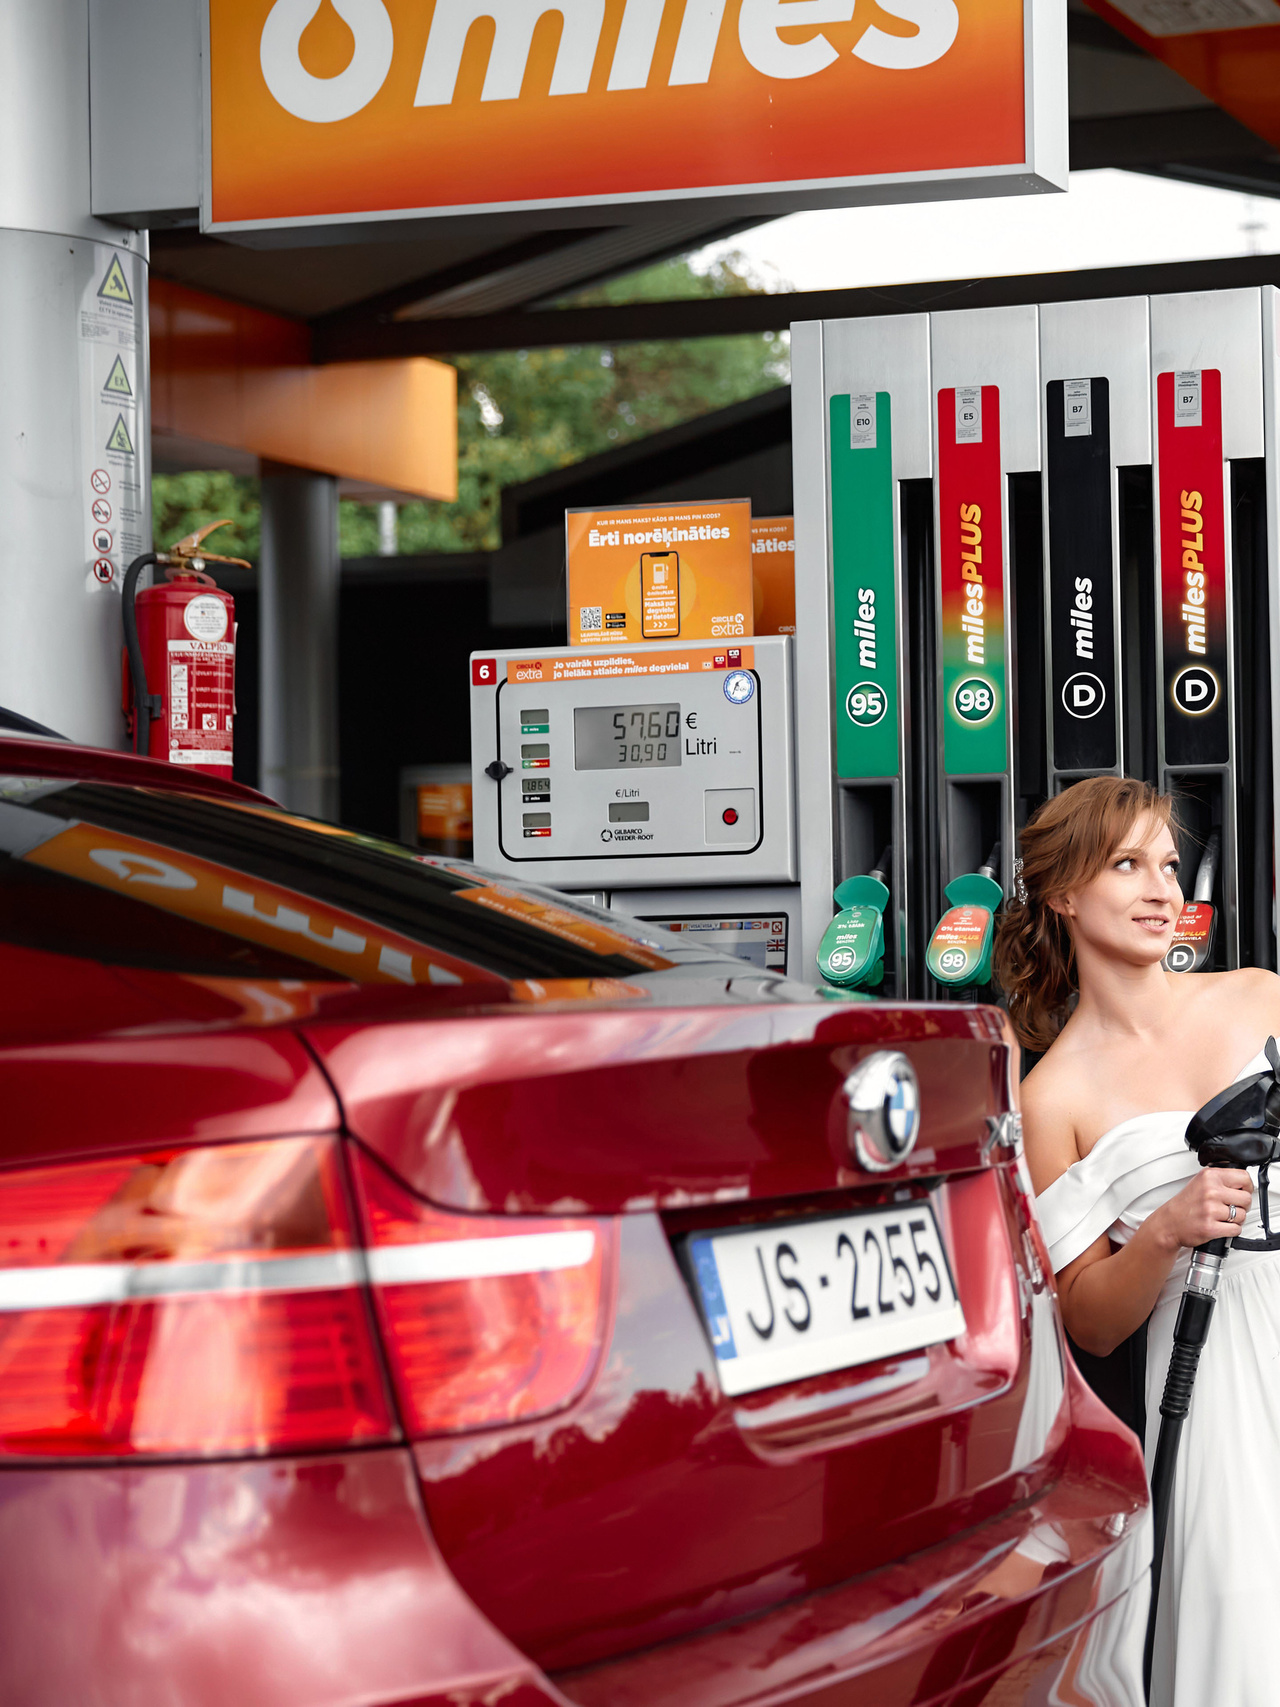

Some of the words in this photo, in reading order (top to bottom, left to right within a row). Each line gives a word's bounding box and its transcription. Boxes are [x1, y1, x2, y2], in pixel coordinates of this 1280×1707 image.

[412, 0, 960, 108] miles
[114, 376, 125, 387] EX
[1183, 396, 1193, 404] B7
[963, 412, 974, 420] E5
[1072, 405, 1083, 413] B7
[856, 418, 870, 426] E10
[652, 515, 667, 523] KĀDS
[588, 529, 620, 547] Ērti
[623, 525, 730, 548] norēķināties
[1070, 577, 1094, 659] miles
[712, 623, 744, 636] extra
[853, 588, 876, 669] miles
[190, 642, 228, 652] VALPRO
[553, 660, 565, 670] Jo
[568, 658, 592, 668] vairāk
[594, 656, 635, 668] uzpildies,
[479, 665, 490, 679] 6
[516, 670, 543, 681] extra
[553, 670, 562, 680] jo
[564, 666, 591, 677] lielāka
[593, 665, 623, 676] atlaide
[624, 664, 648, 675] miles
[649, 662, 689, 674] degvielai
[1073, 684, 1096, 707] D
[1185, 679, 1208, 702] D
[851, 692, 882, 716] 95
[958, 688, 990, 712] 98
[685, 712, 697, 729] €
[686, 738, 717, 756] Litri
[615, 789, 640, 798] €/Litri
[836, 933, 858, 941] miles
[831, 952, 853, 967] 95
[942, 953, 964, 968] 98
[1172, 951, 1189, 966] D
[747, 1219, 941, 1340] JS-2255
